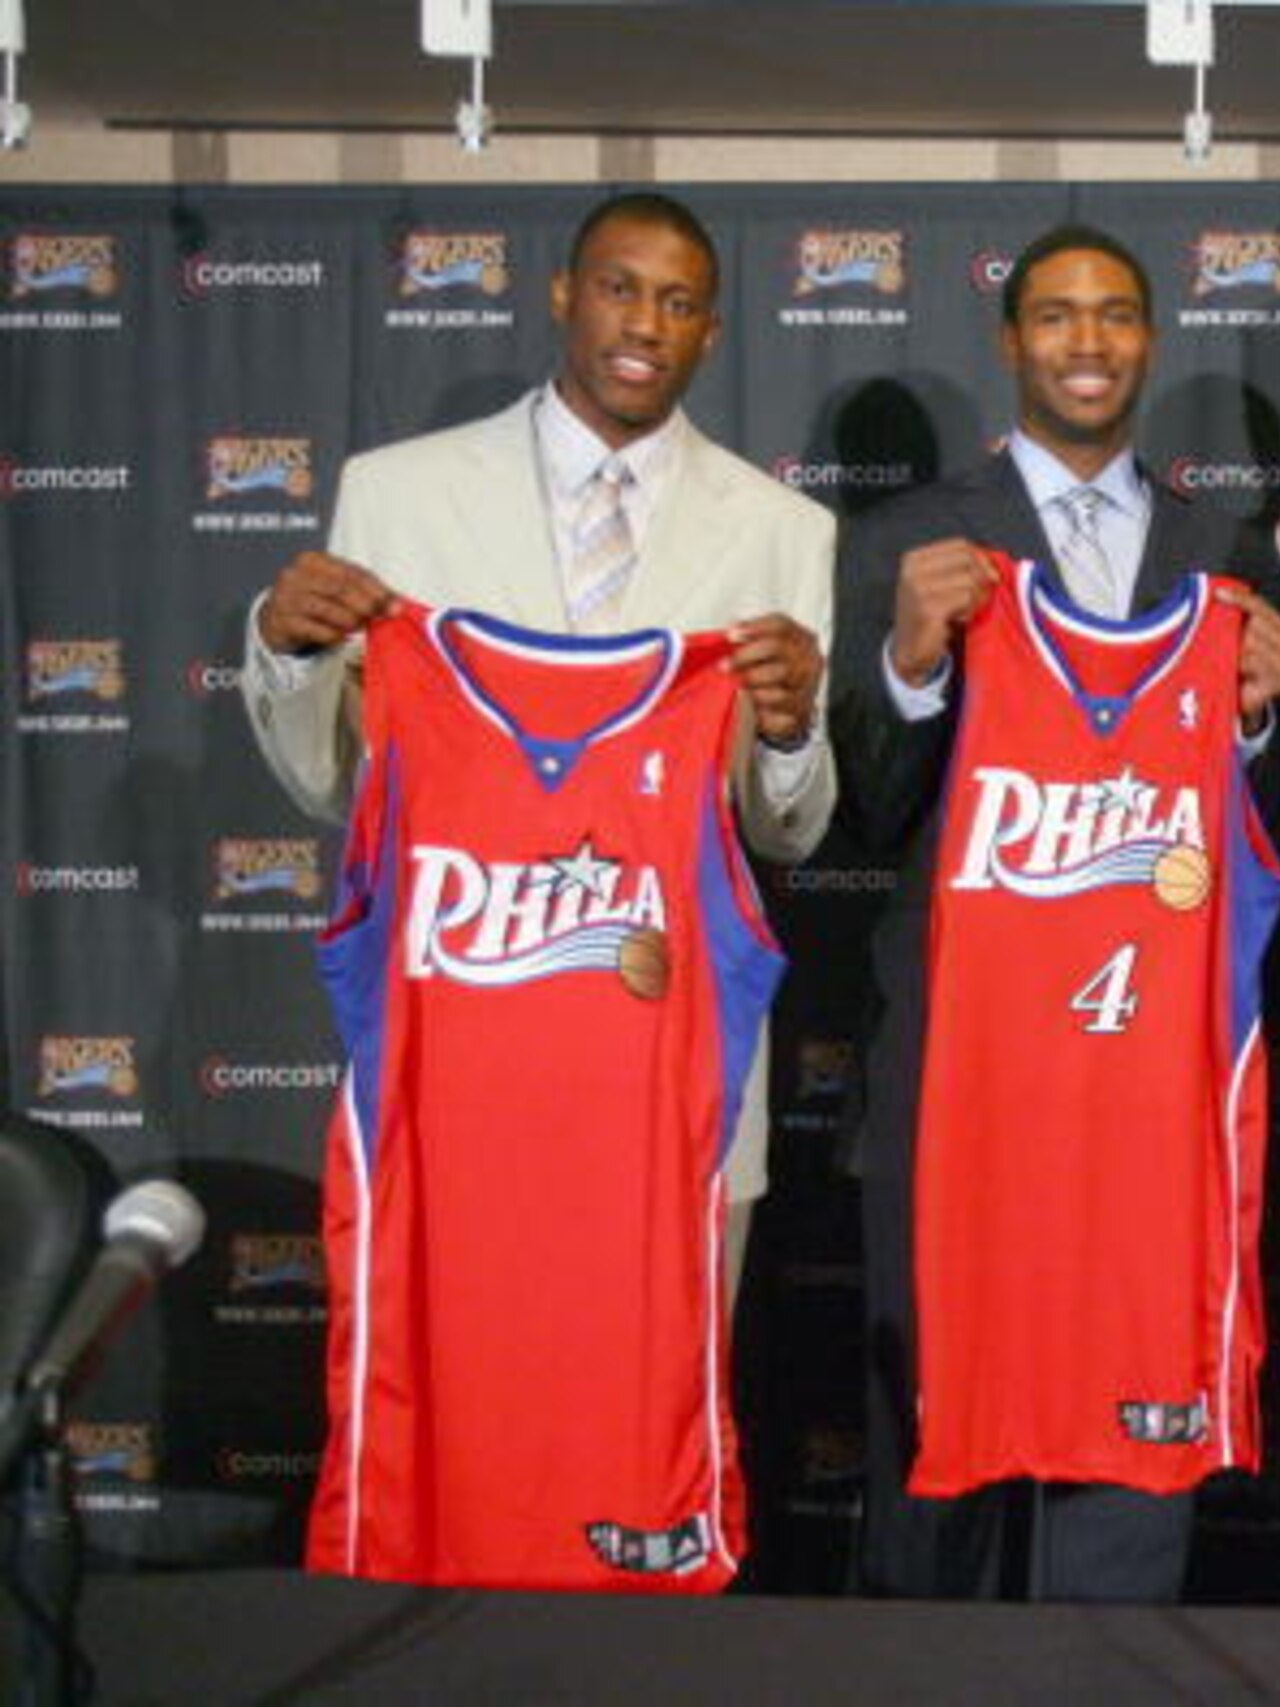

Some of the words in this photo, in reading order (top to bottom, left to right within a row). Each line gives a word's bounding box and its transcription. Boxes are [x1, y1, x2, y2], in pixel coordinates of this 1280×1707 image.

[196, 260, 322, 286] comcast
[10, 465, 130, 489] comcast
[29, 864, 138, 890] comcast
[1070, 942, 1138, 1034] 4
[213, 1063, 339, 1088] comcast
